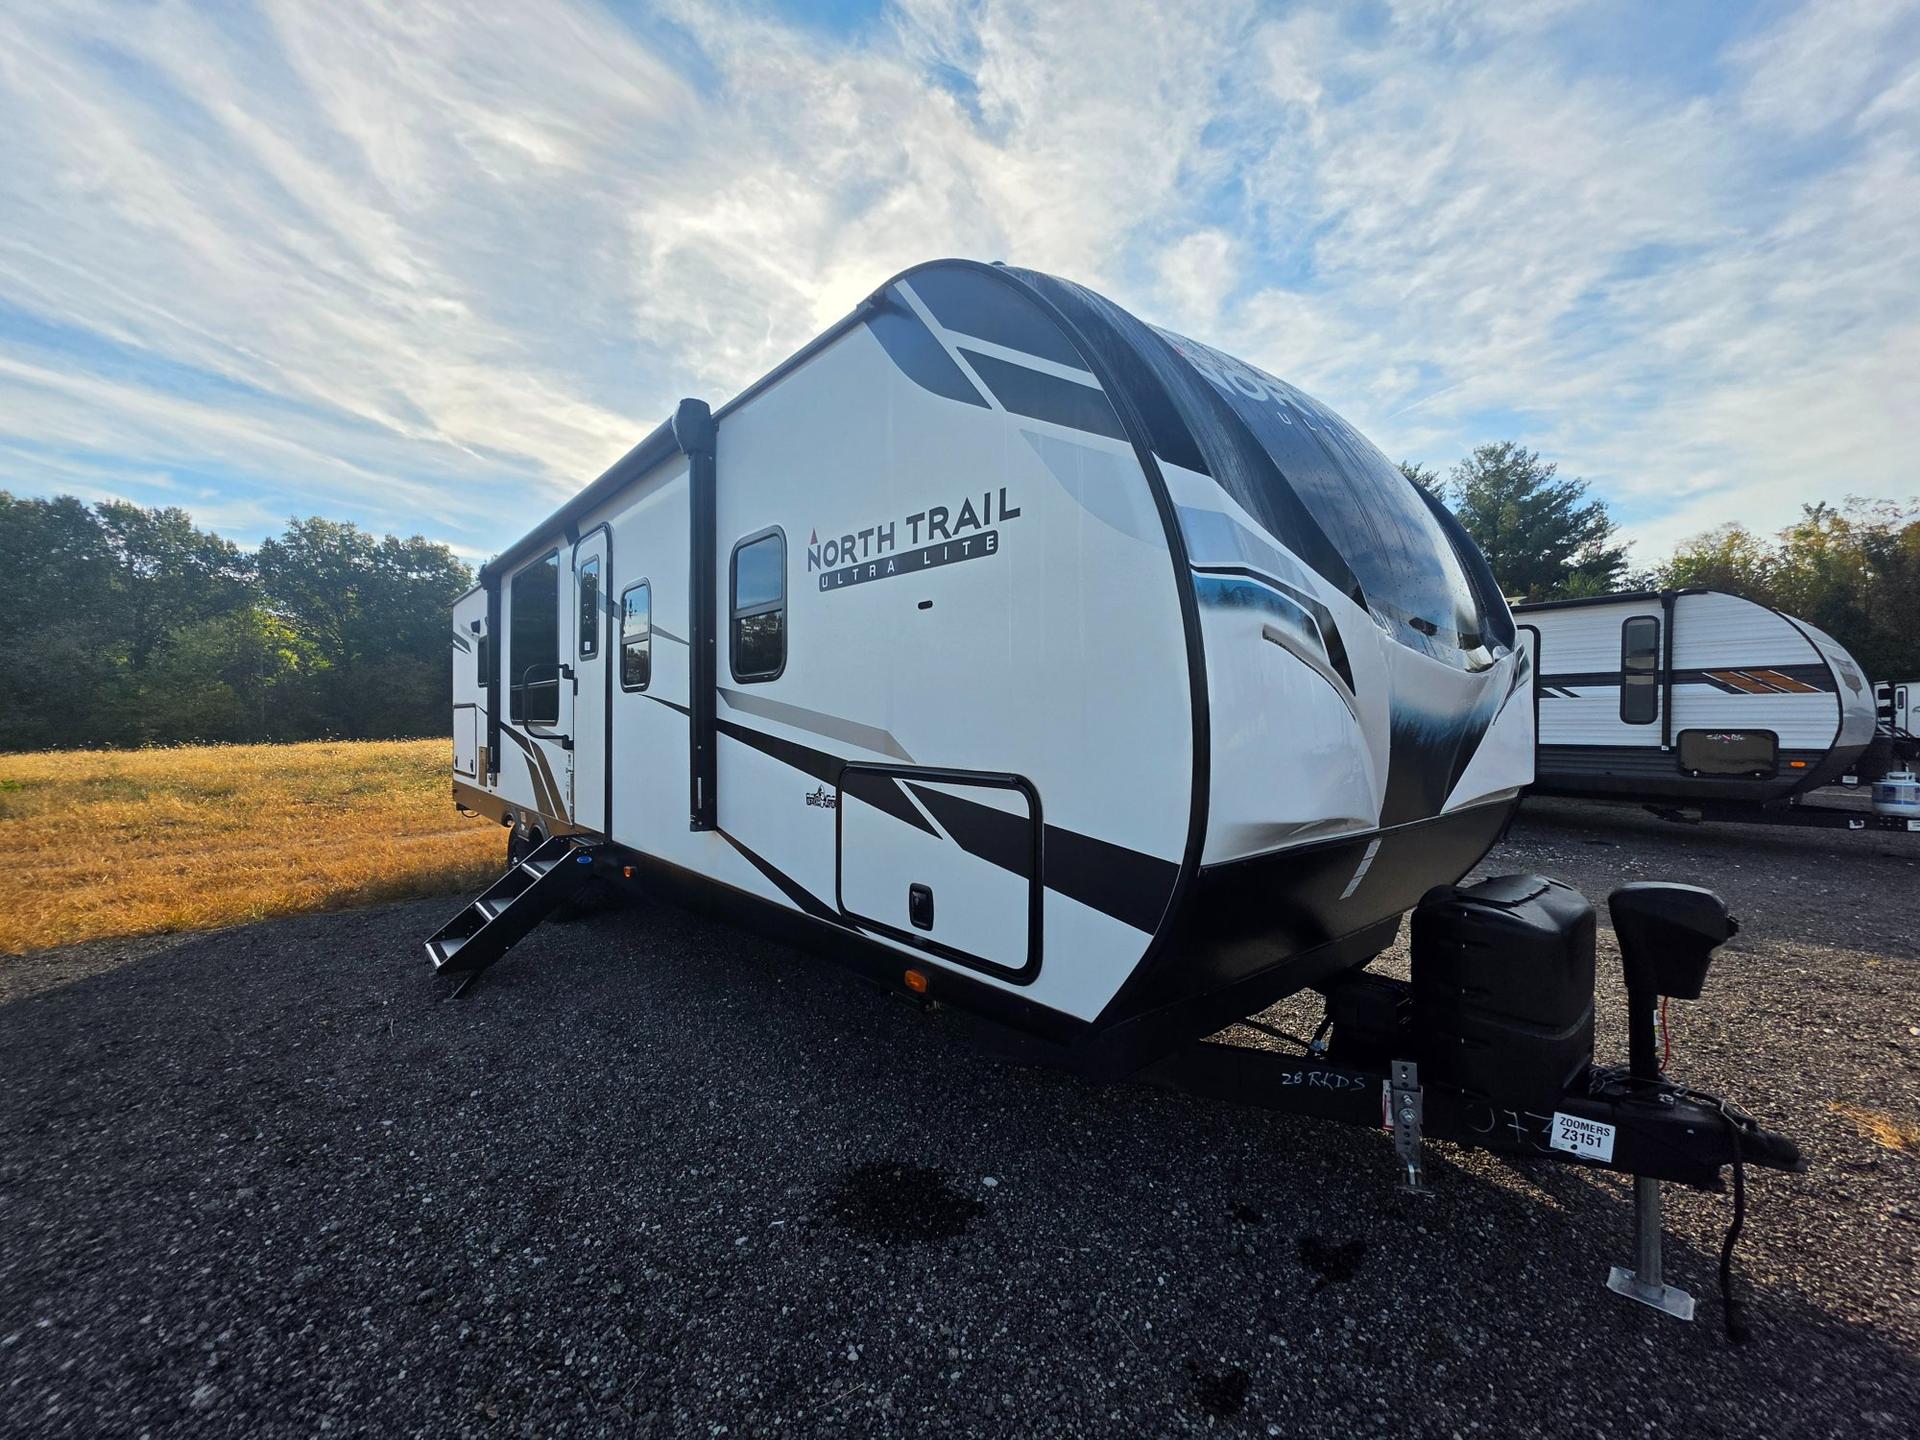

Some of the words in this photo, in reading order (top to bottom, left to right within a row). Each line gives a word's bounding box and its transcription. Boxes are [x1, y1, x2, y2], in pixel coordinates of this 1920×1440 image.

[807, 521, 895, 572] NORTH
[906, 487, 1021, 544] TRAIL
[821, 559, 896, 588] ULTRA
[923, 534, 995, 565] LITE
[1559, 1116, 1611, 1137] ZOOMERS
[1561, 1127, 1602, 1148] Z3151
